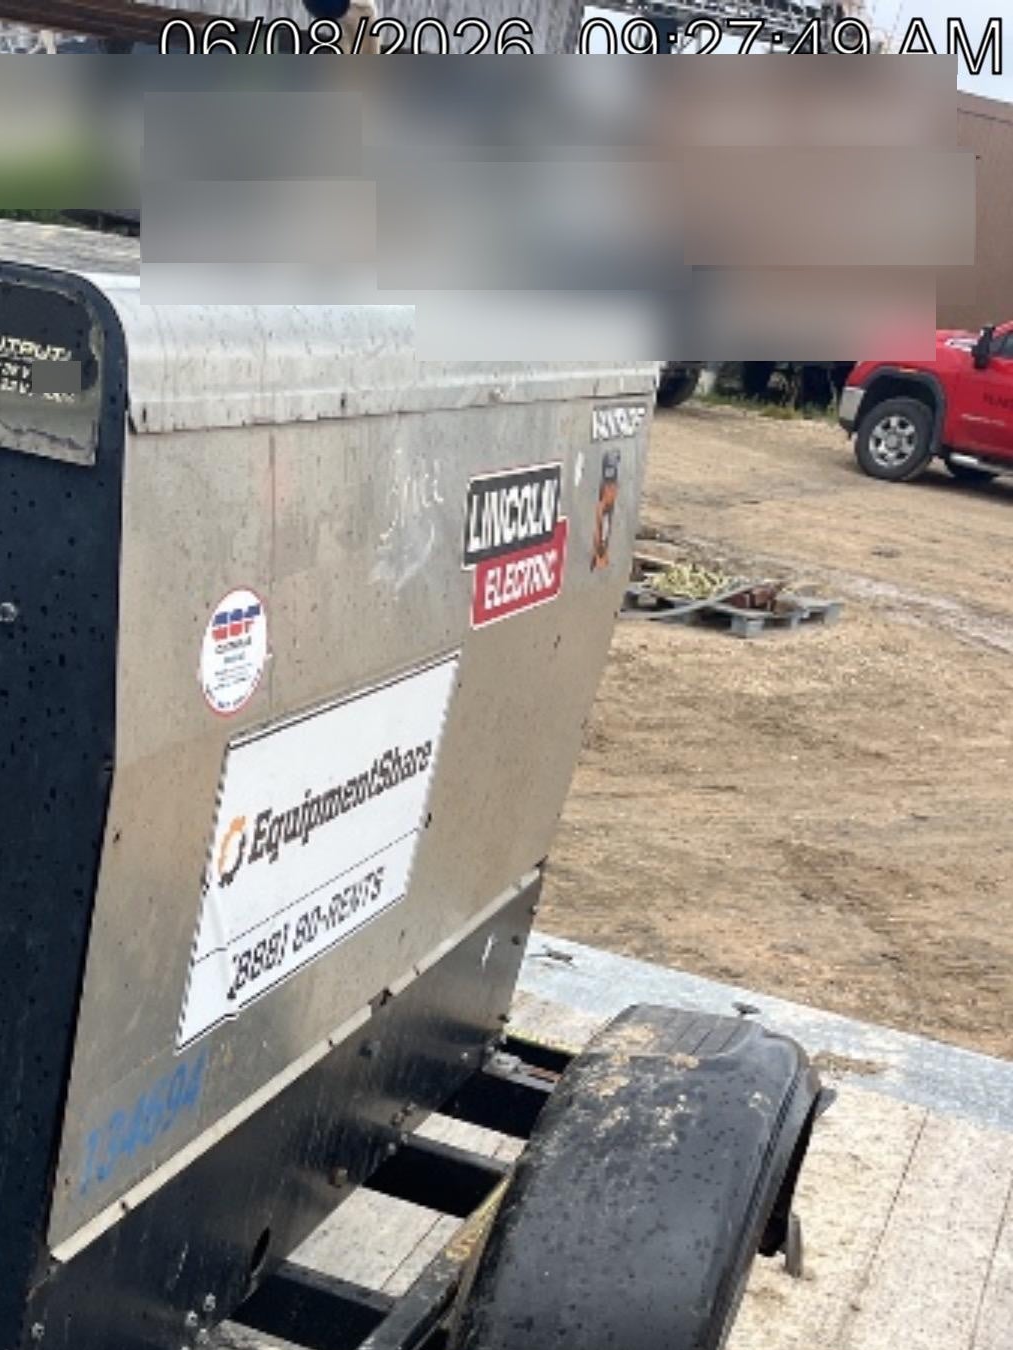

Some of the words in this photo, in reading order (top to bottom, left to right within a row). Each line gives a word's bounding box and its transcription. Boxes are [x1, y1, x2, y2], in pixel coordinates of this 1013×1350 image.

[467, 479, 559, 554] LINCOLN
[484, 549, 558, 611] ELECTRIC
[248, 740, 433, 865] EquipmentShare
